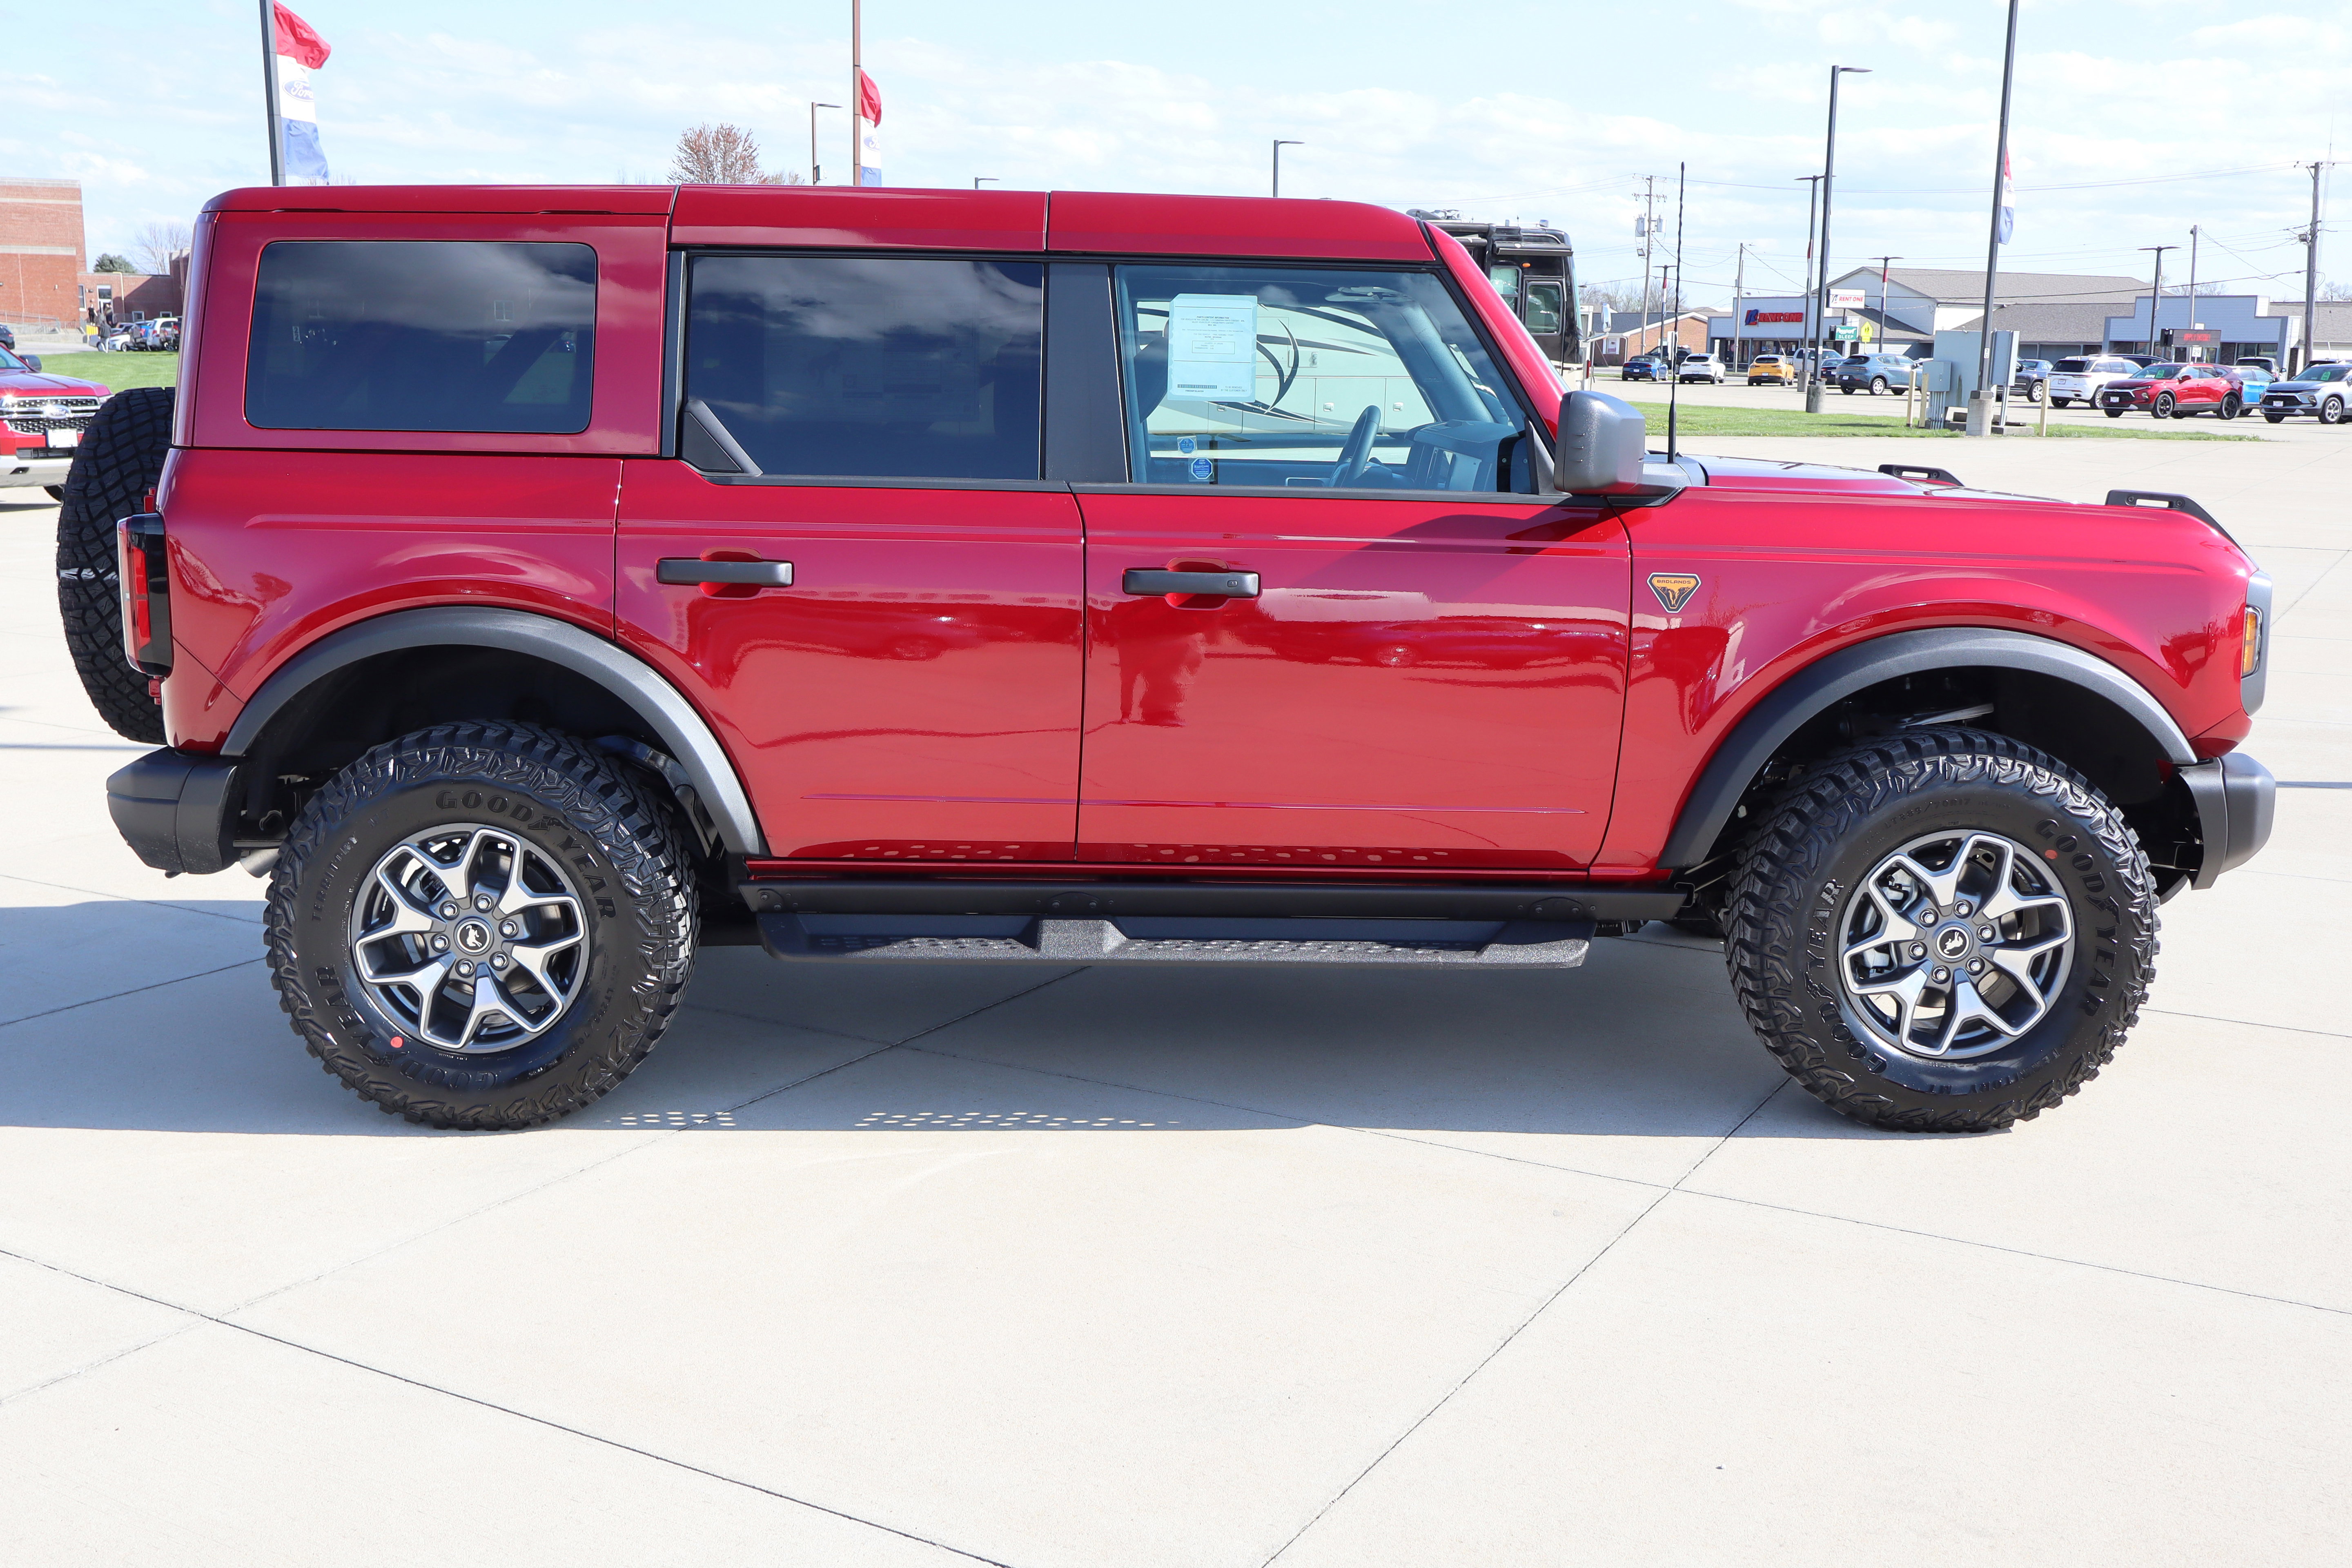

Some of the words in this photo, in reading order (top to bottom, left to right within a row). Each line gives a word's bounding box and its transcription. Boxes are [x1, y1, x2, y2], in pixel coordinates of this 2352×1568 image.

[1759, 313, 1783, 322] RENT
[1783, 312, 1803, 322] ONE
[436, 790, 616, 918] GOODYEAR
[2035, 819, 2117, 1016] GOODYEAR
[1807, 879, 1887, 1074] GOODYEAR
